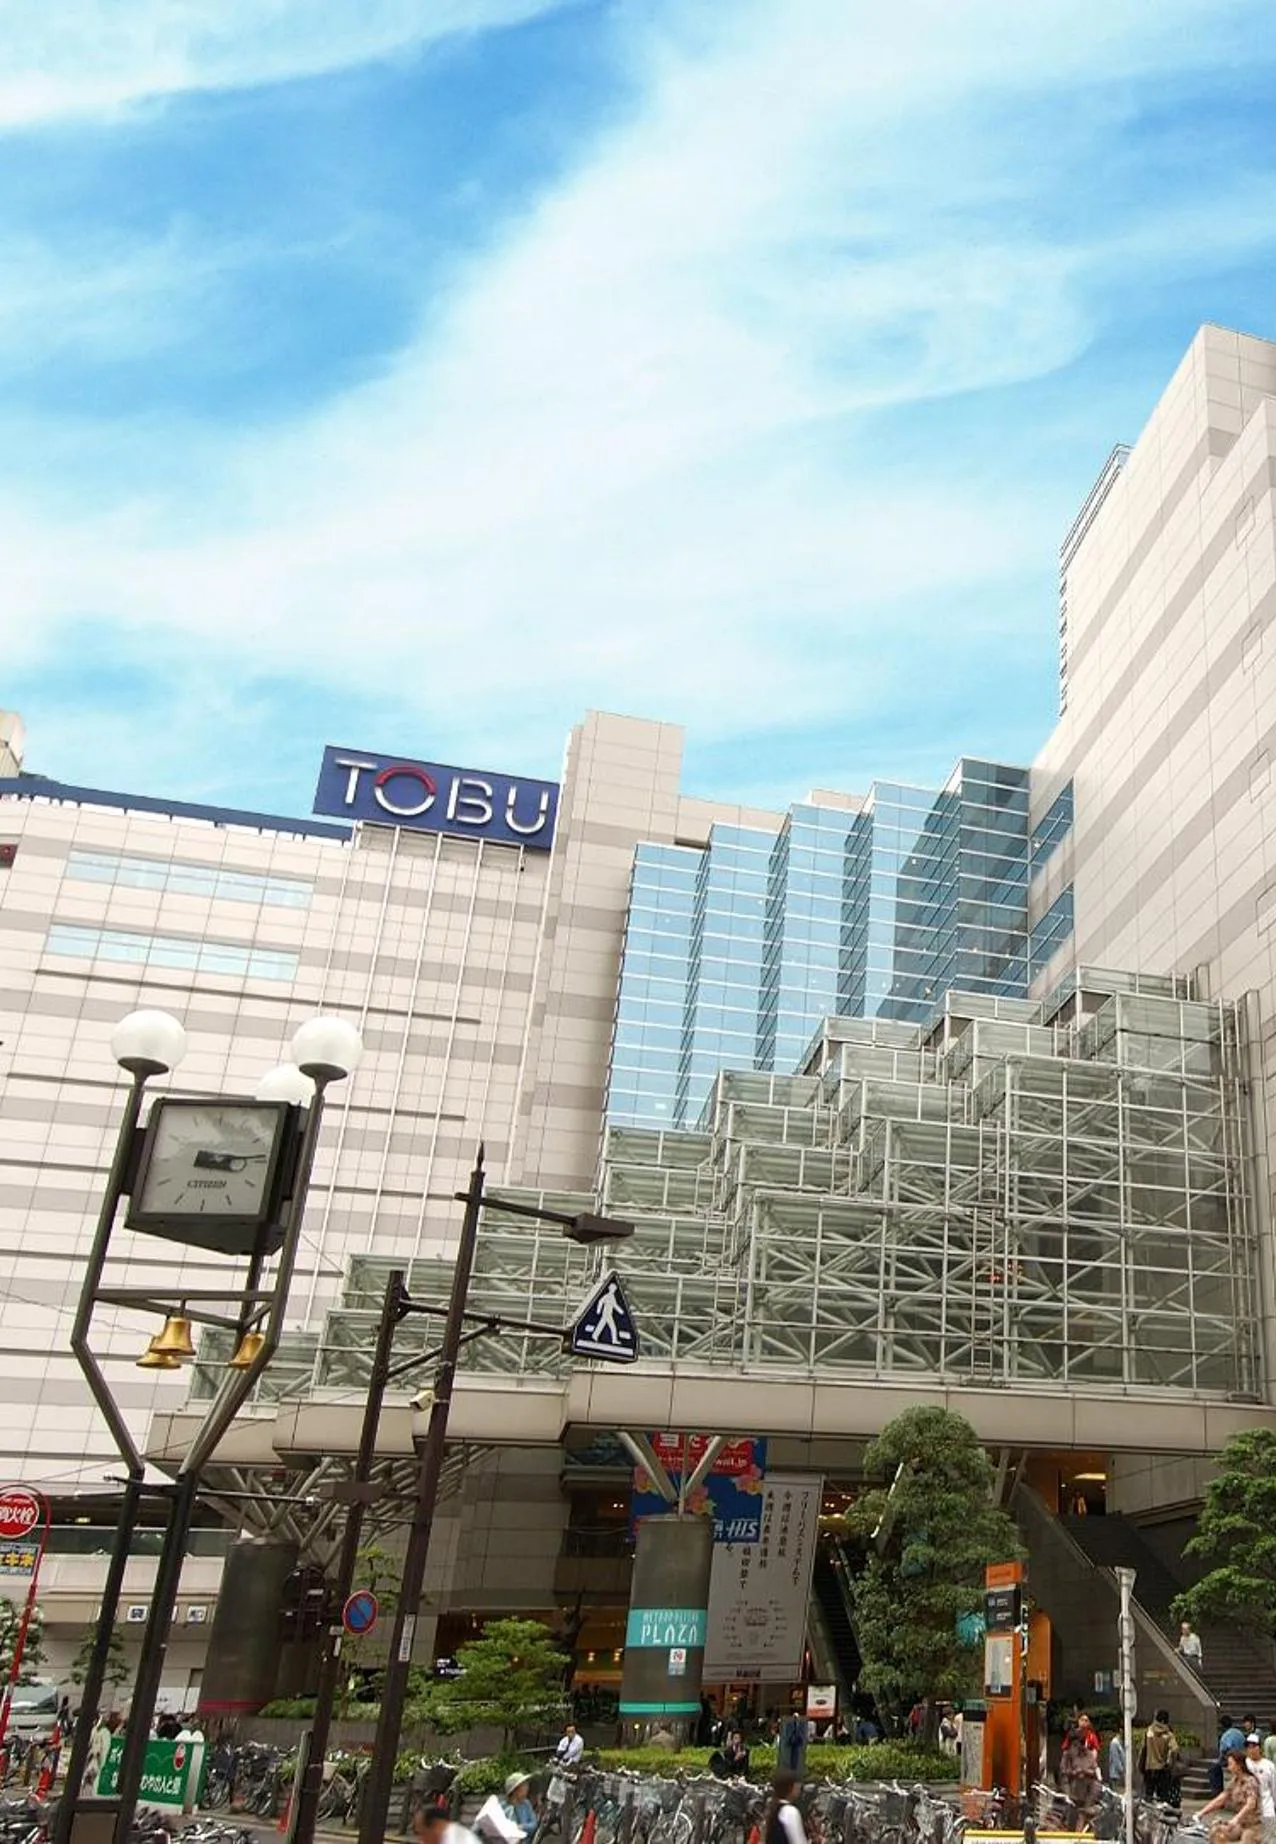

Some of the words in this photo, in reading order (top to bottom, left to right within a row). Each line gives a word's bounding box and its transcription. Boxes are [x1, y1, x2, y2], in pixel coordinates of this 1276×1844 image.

[334, 756, 549, 834] TOBU
[187, 1180, 227, 1189] CITIZEN
[640, 1623, 698, 1645] PLAZA
